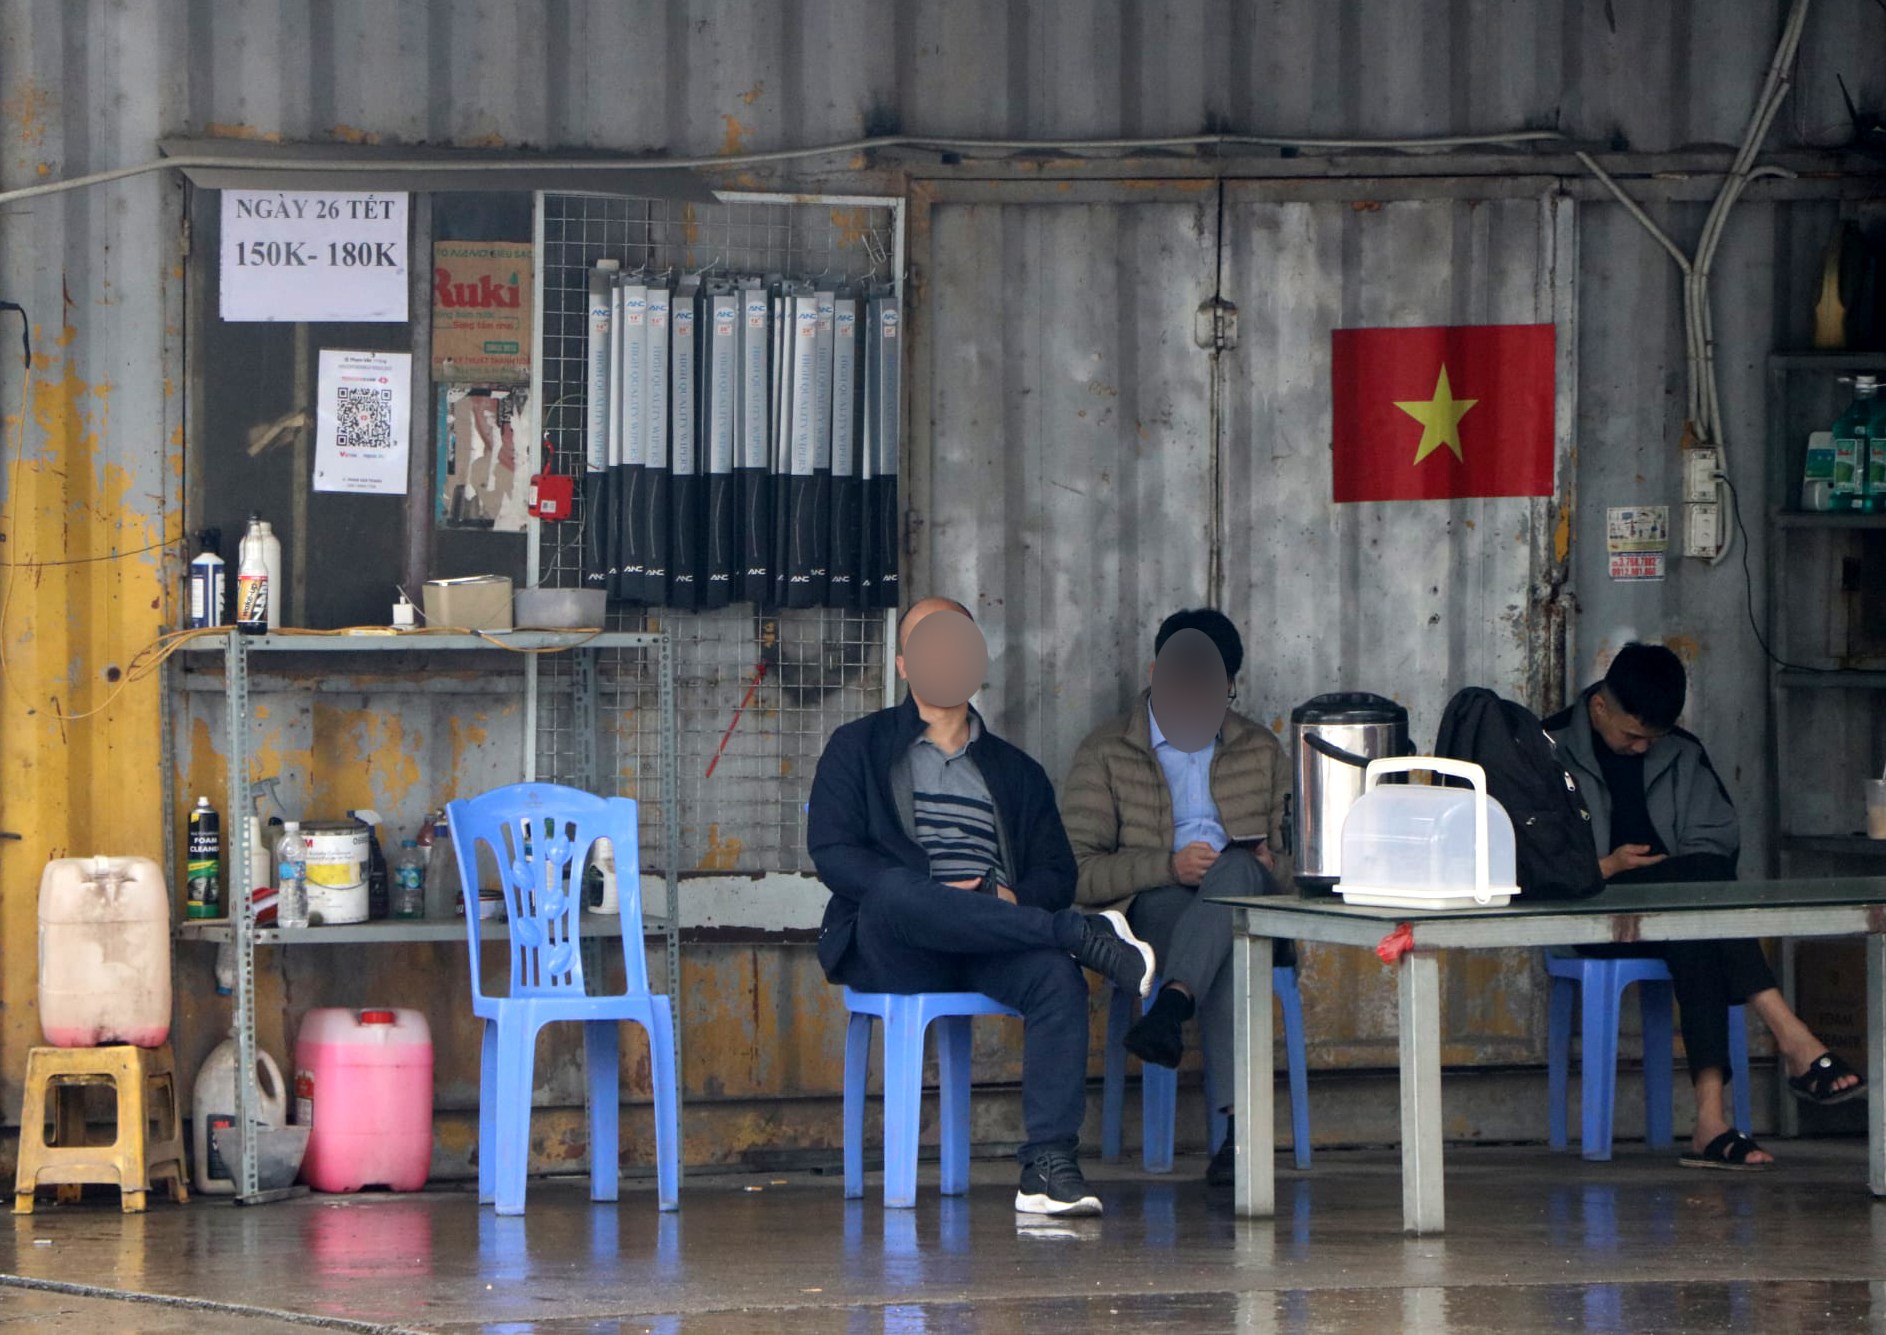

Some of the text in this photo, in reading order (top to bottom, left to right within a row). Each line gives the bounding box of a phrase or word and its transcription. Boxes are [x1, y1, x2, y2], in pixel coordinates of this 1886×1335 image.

[236, 193, 395, 219] NGÀY 26 TẾT
[236, 241, 398, 267] 150K- 180K
[433, 267, 520, 308] Ruki
[676, 312, 693, 320] ANC
[679, 353, 688, 380] HIGH
[624, 565, 643, 573] ANC
